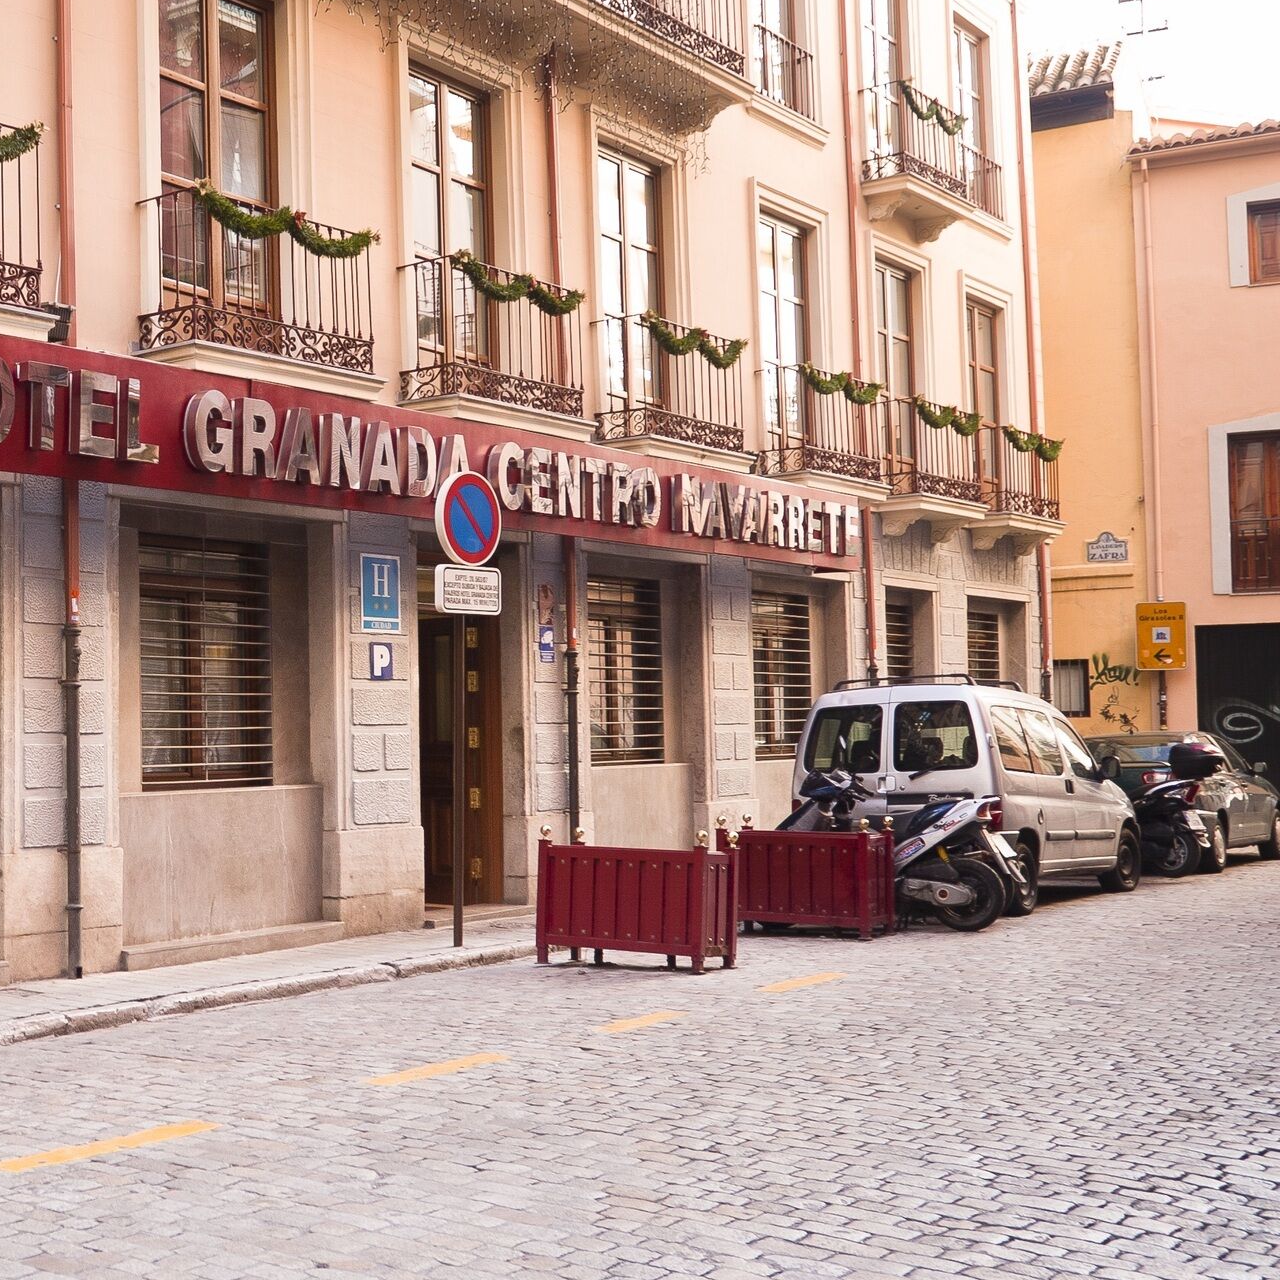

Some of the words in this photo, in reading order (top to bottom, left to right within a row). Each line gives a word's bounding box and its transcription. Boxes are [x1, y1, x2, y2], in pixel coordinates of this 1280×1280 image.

[487, 441, 662, 529] CENTRO
[671, 472, 862, 557] NAVARRETE
[1090, 552, 1125, 560] ZAFRA
[372, 563, 391, 598] H
[444, 581, 461, 589] EXCEPTO
[371, 621, 392, 629] CIUDAD
[373, 644, 391, 677] P
